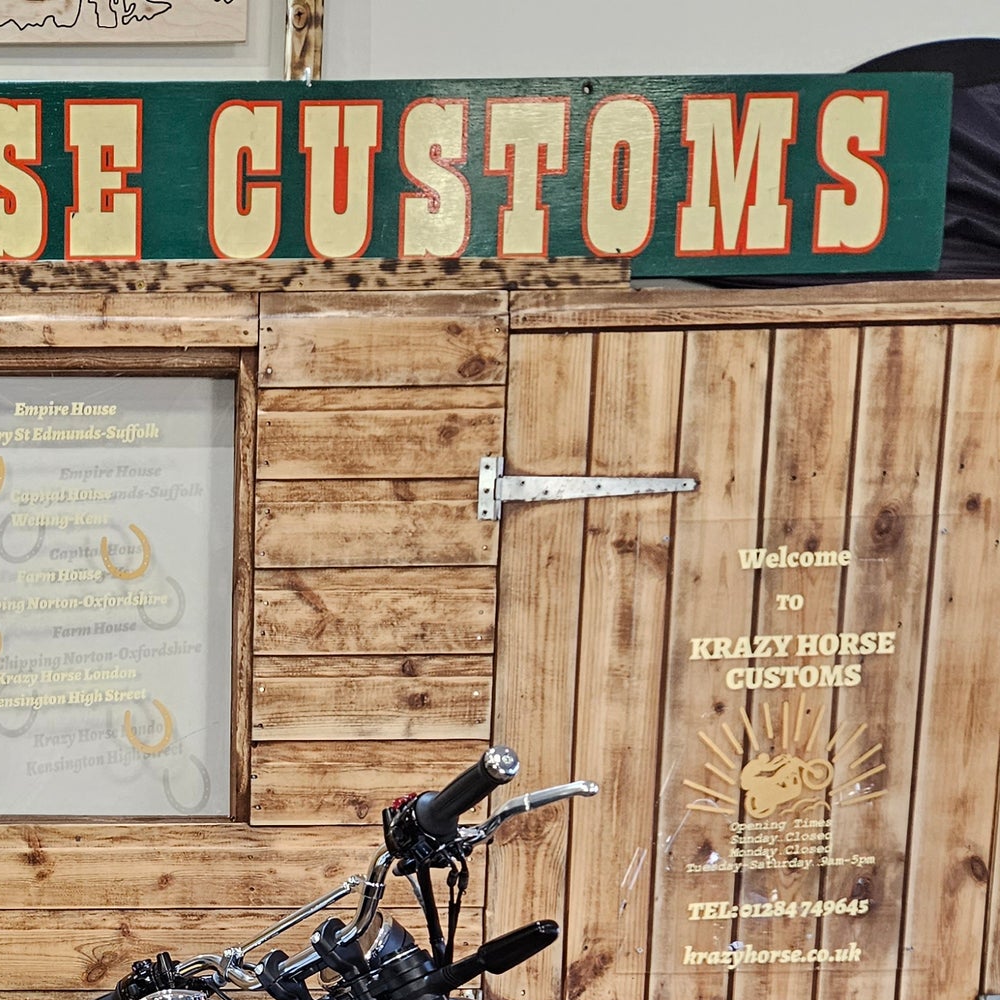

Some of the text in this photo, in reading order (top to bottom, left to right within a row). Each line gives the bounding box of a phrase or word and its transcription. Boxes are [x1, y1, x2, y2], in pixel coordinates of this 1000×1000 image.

[209, 90, 889, 259] CUSTOMS
[14, 401, 117, 420] Empire House
[14, 427, 31, 442] St
[31, 424, 160, 443] Edmunds-Suffolk
[738, 545, 852, 570] Welcome
[16, 570, 57, 584] Farm
[57, 568, 102, 583] House
[26, 591, 169, 611] Norton-Oxfordshire
[776, 594, 804, 611] TO
[689, 631, 897, 661] KRAZY HORSE
[40, 669, 82, 683] Horse
[84, 666, 137, 681] London
[725, 664, 862, 690] CUSTOMS
[67, 690, 104, 706] High
[105, 687, 147, 702] Street
[729, 818, 833, 833] Opening Times
[799, 898, 870, 918] 749645
[683, 942, 862, 970] krazyhorse.co.uk
